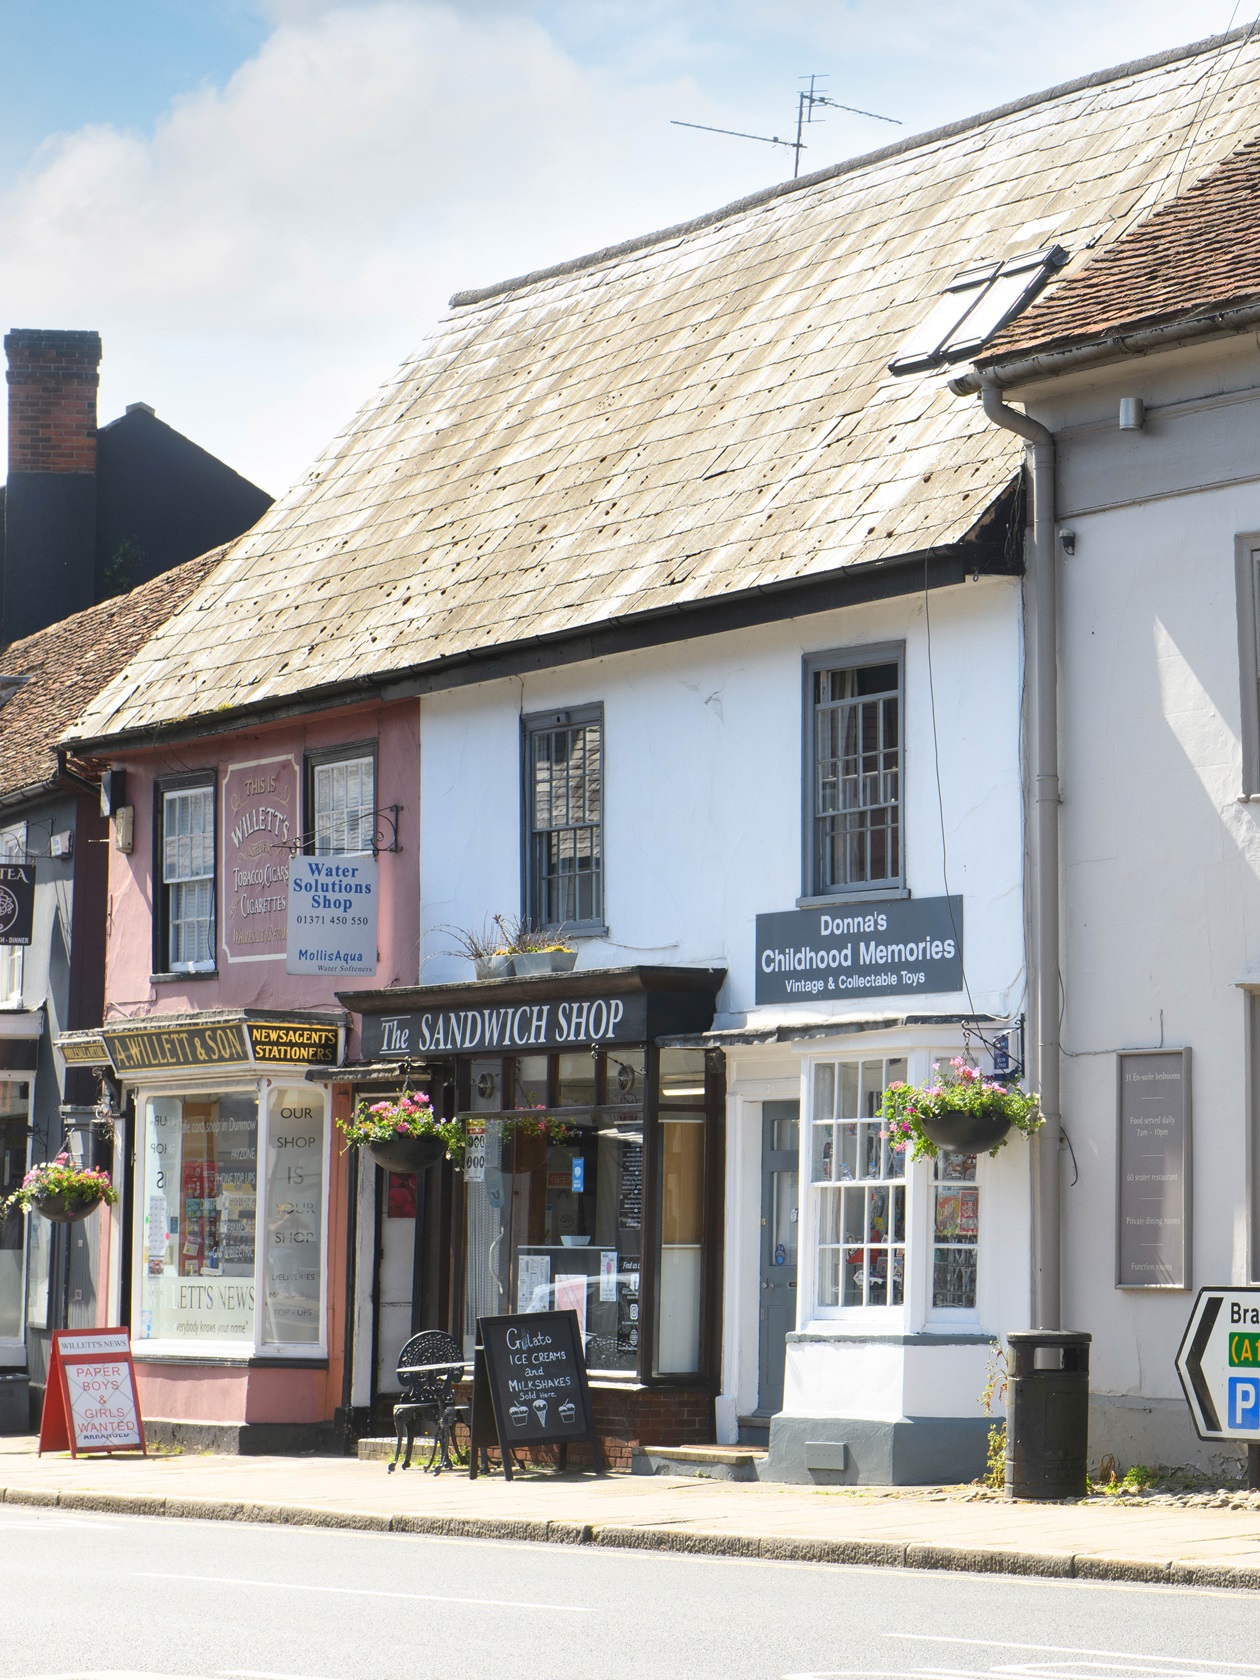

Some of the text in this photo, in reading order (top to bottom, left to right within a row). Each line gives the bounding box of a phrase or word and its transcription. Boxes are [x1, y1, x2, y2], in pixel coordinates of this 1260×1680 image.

[245, 776, 277, 797] THIS IS
[231, 806, 290, 849] WILLETT'S
[307, 862, 359, 878] Water
[293, 878, 372, 895] Solutions
[240, 893, 287, 919] CIGARETTES
[311, 894, 353, 912] Shop
[296, 915, 369, 926] 01371 450 550
[820, 911, 888, 936] Donna's
[9, 936, 29, 944] DINNER
[298, 949, 363, 964] MollisAqua
[761, 935, 956, 973] Childhood Memories
[317, 964, 373, 973] Water Softeners
[785, 970, 926, 994] Vintage & Collectable Toys
[380, 999, 624, 1052] The SANDWICH SHOP
[252, 1028, 336, 1045] NEWSAGENTS
[193, 1037, 207, 1060] &
[205, 1028, 243, 1060] SON
[255, 1045, 333, 1060] STATIONERS
[1125, 1071, 1181, 1082] 31 En-suite bedrooms
[280, 1107, 312, 1119] OUR
[1130, 1115, 1175, 1126] Food served daily
[1137, 1128, 1148, 1137] 7am
[1154, 1128, 1169, 1138] 10pm
[277, 1136, 316, 1149] SHOP
[287, 1167, 304, 1185] IS
[1127, 1173, 1134, 1182] 60
[1126, 1216, 1145, 1225] Private
[1145, 1216, 1164, 1227] dining
[275, 1231, 314, 1244] SHOP
[622, 1261, 632, 1270] Find
[1131, 1262, 1155, 1271] Function
[271, 1273, 315, 1281] DELIVERIES
[216, 1286, 255, 1311] NEWS
[273, 1308, 290, 1316] TOP
[296, 1308, 313, 1316] UPS
[173, 1319, 199, 1336] verybody
[200, 1319, 217, 1333] knows
[217, 1322, 230, 1336] your
[61, 1339, 127, 1350] WILLETT'S NEWS
[509, 1351, 567, 1366] ICE CREAMS
[76, 1366, 121, 1378] PAPER
[524, 1366, 545, 1377] and
[82, 1380, 120, 1391] BOYS
[508, 1376, 572, 1392] MILKSHAKES
[98, 1394, 107, 1405] &
[519, 1391, 537, 1401] Sold
[1236, 1383, 1256, 1424] P
[84, 1407, 125, 1419] GIRLS
[77, 1420, 136, 1433] WANTED
